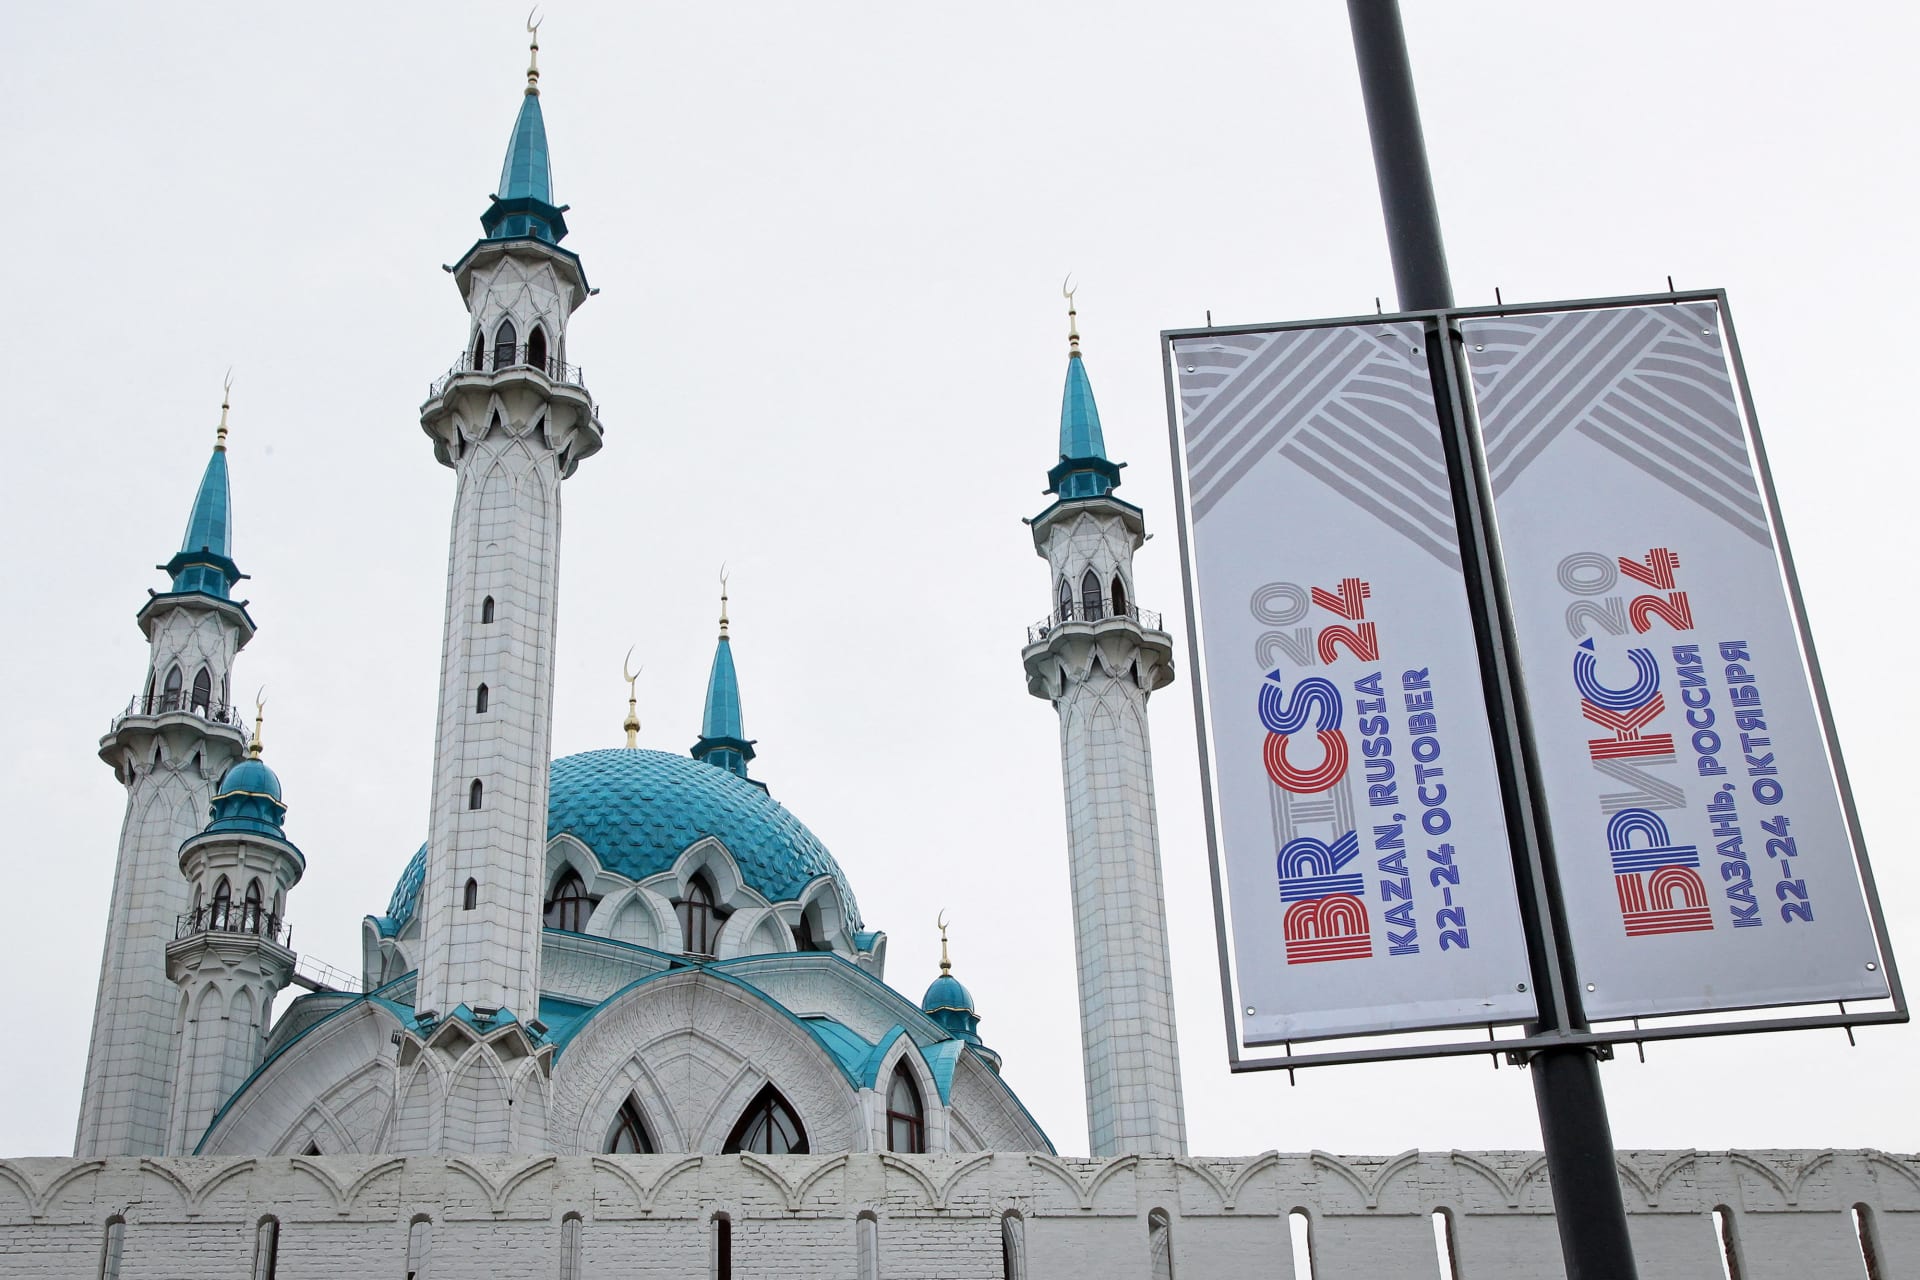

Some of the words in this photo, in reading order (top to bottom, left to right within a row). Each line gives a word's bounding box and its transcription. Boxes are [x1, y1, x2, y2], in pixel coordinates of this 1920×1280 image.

[1250, 581, 1316, 670] 20
[1311, 578, 1379, 665] 24
[1557, 551, 1630, 640] 20
[1618, 547, 1694, 635] 24
[1354, 671, 1399, 807] RUSSIA
[1402, 667, 1451, 836] OCTOBER
[1672, 644, 1728, 777] РОССИЯ
[1718, 640, 1784, 806] ОКТЯБРЯ
[1258, 677, 1373, 965] BRICS
[1573, 648, 1714, 937] БРИКС
[1706, 782, 1763, 929] КАЗАНЬ,
[1372, 812, 1420, 956] KAZAN,
